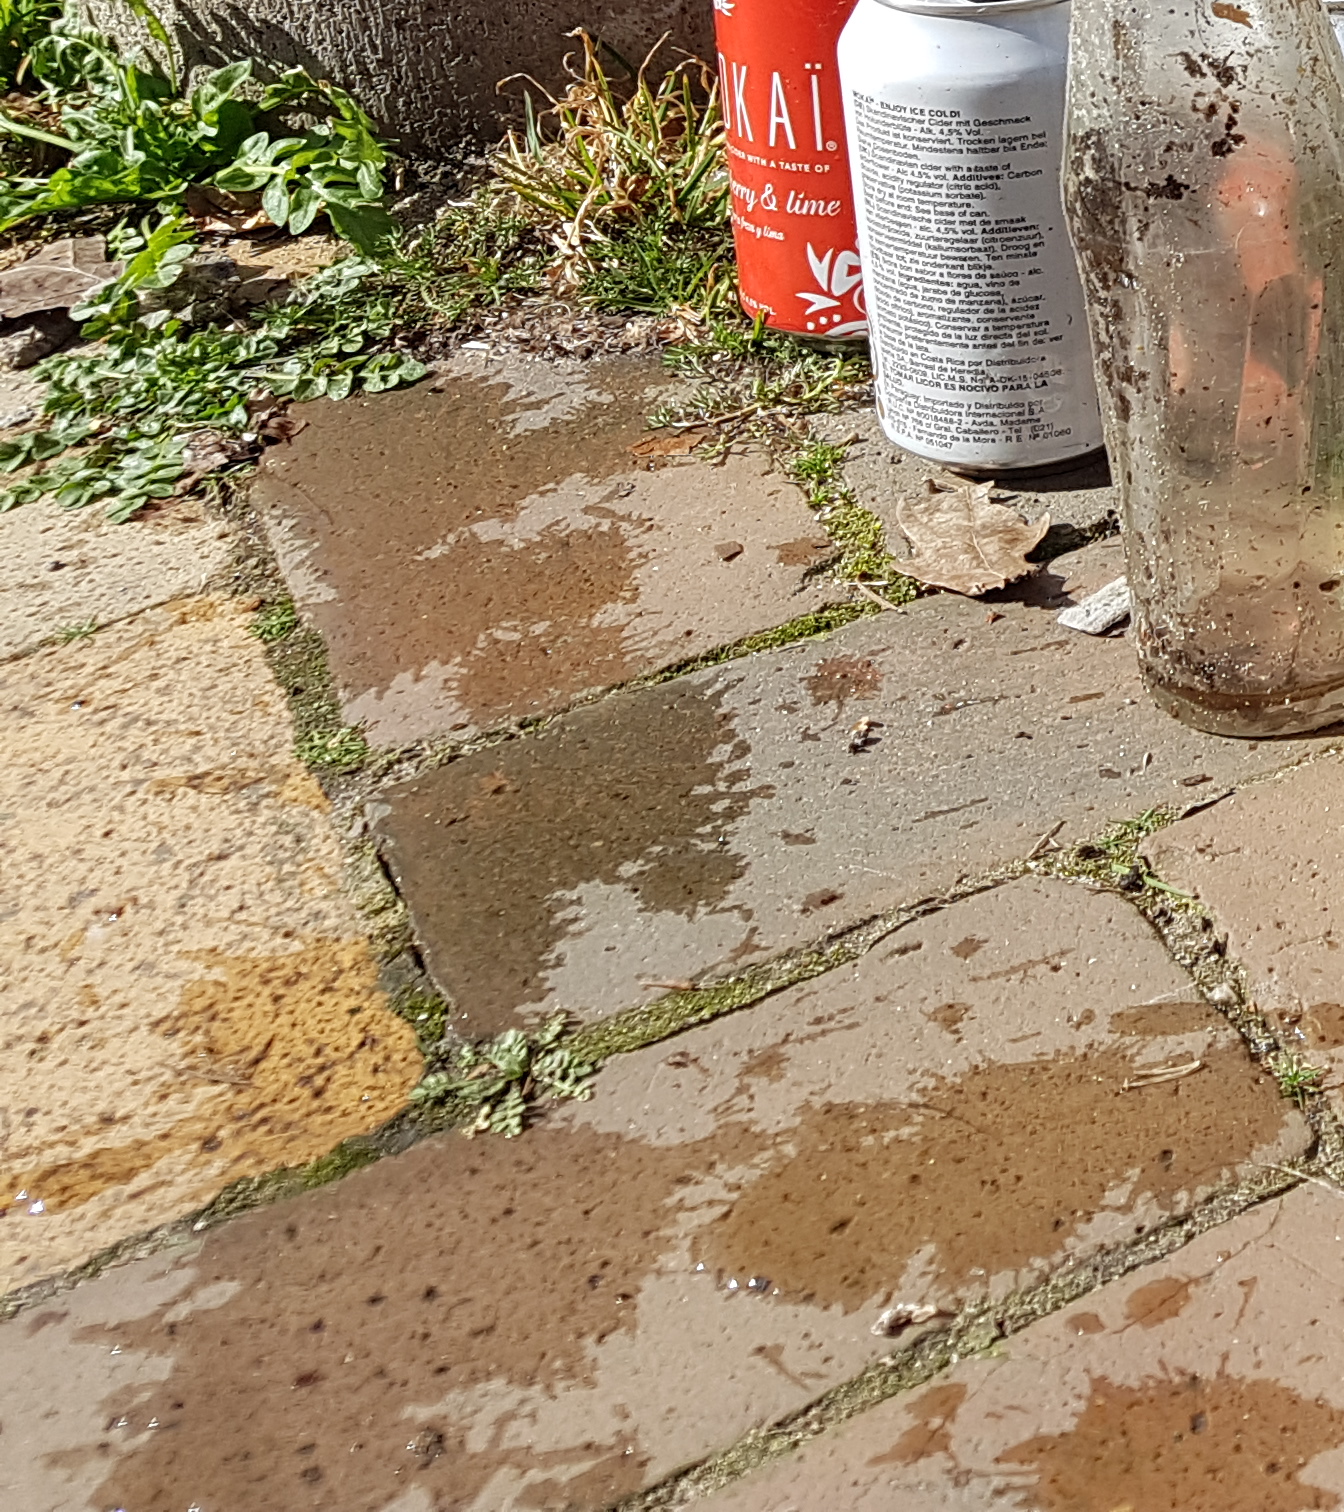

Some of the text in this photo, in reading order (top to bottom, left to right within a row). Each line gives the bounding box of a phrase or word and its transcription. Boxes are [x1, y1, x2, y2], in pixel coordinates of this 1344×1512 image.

[910, 107, 926, 116] ICE
[964, 128, 983, 136] Vol.
[957, 137, 995, 146] Trocken
[1002, 143, 1017, 152] bis
[779, 161, 810, 173] TASTE
[815, 165, 830, 173] OF
[945, 164, 963, 173] with
[1002, 162, 1011, 171] of
[952, 168, 1043, 182] Additives: Carbon
[760, 183, 778, 211] &
[786, 190, 841, 216] lime
[915, 204, 990, 218] See of can.
[959, 218, 991, 227] met de
[1001, 242, 1030, 252] Droog
[986, 253, 1002, 262] Ten
[975, 270, 987, 279] de
[983, 305, 995, 314] de
[1016, 330, 1031, 339] del
[944, 381, 956, 391] ES
[959, 384, 999, 393] NOCIVO
[1002, 382, 1030, 392] PARA
[1034, 380, 1048, 389] LA
